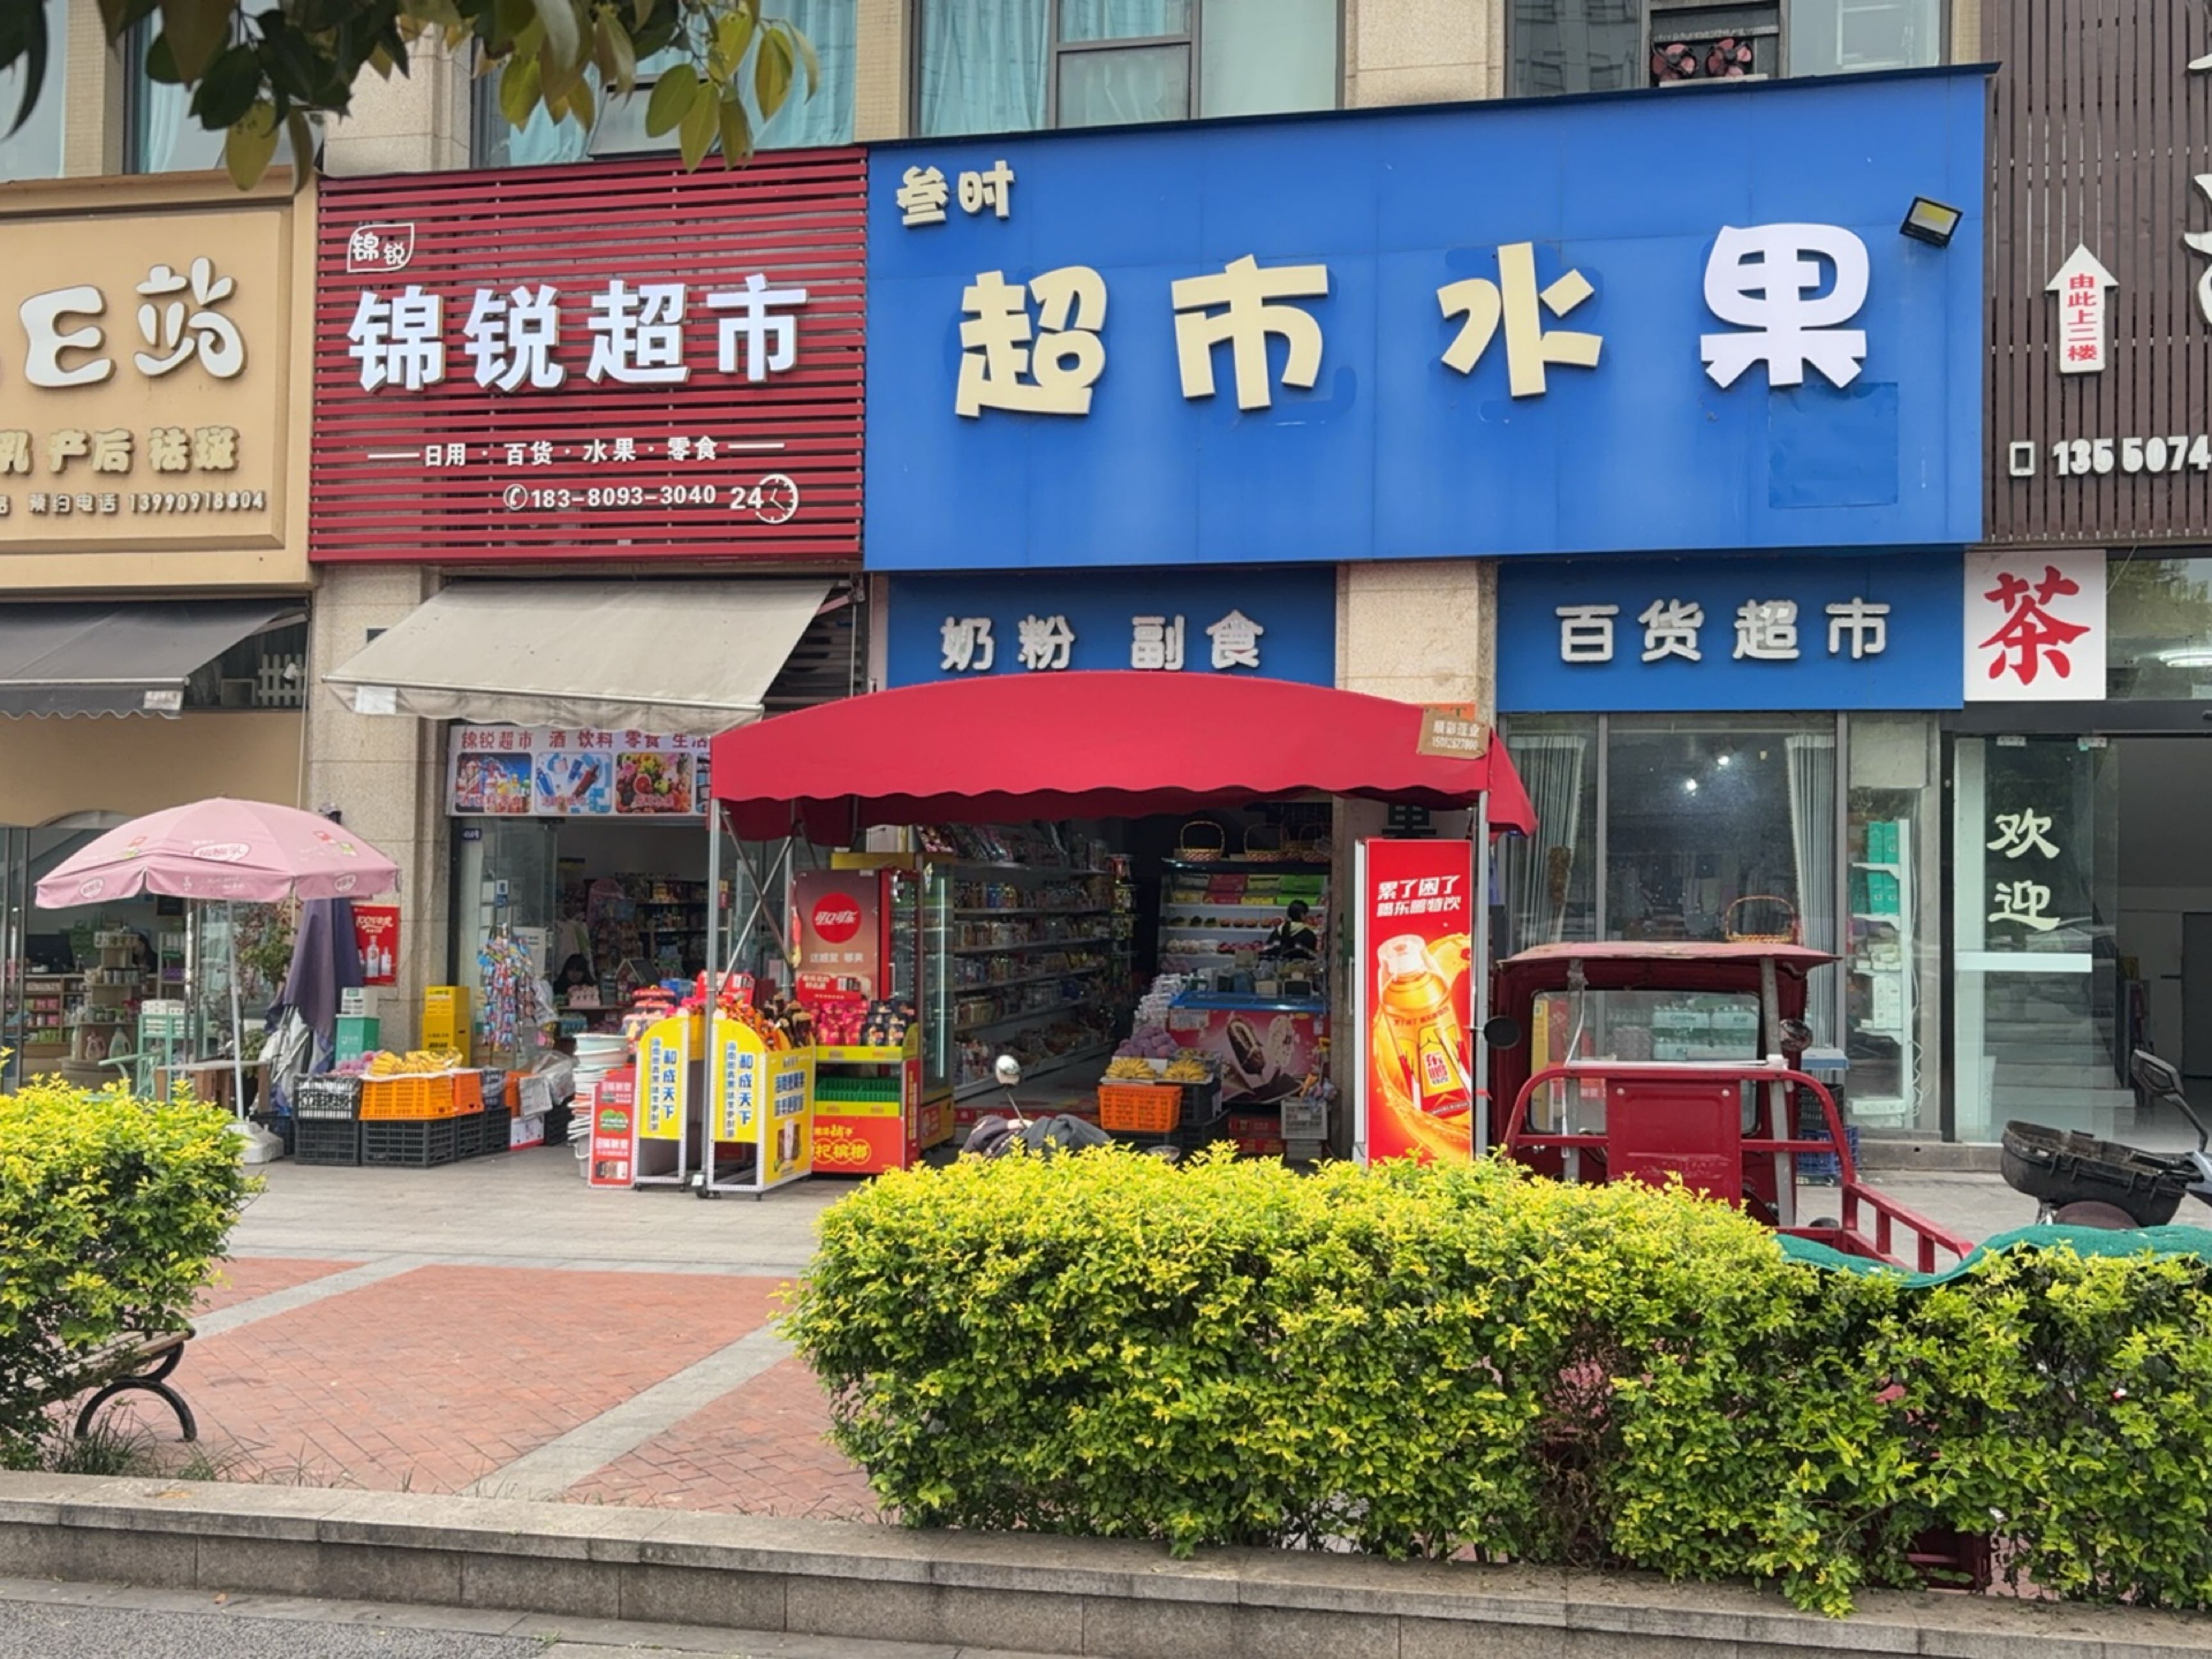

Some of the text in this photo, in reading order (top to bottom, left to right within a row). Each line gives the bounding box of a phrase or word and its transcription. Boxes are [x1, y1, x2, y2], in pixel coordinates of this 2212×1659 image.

[897, 161, 1014, 226] 叁时
[351, 231, 405, 266] 锦锐
[348, 273, 809, 392] 锦锐超市
[956, 223, 1870, 417] 超市水果
[2067, 273, 2097, 361] 由此上二楼
[29, 492, 120, 514] 预约电话
[531, 485, 764, 510] 183-8093-3040 24
[940, 609, 1265, 672] 奶粉 副食
[1555, 597, 1891, 664] 百货超市
[1978, 565, 2091, 686] 茶
[461, 730, 534, 750] 锦锐超市
[549, 730, 566, 748] 酒
[577, 729, 613, 748] 饮料
[1377, 875, 1461, 901] 累了困了
[1986, 807, 2060, 931] 欢迎
